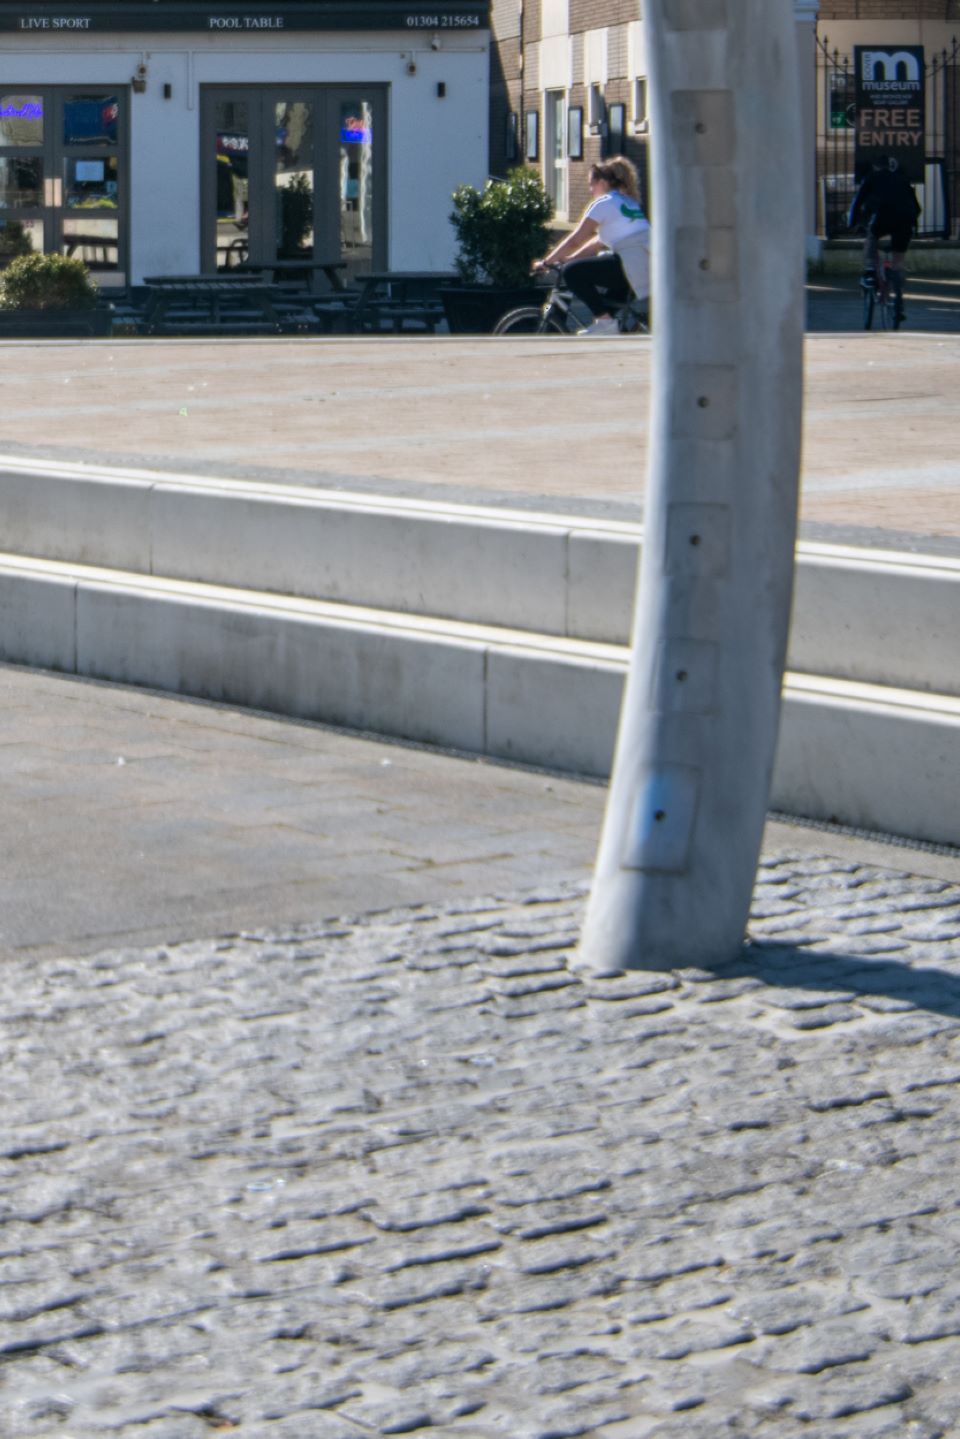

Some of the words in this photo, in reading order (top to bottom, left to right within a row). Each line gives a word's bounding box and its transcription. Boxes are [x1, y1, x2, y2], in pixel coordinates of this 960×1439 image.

[21, 18, 50, 29] LIVE
[52, 18, 91, 29] SPORT
[209, 18, 242, 28] POOL
[243, 18, 284, 28] TABLE
[407, 16, 438, 26] 01304
[440, 16, 479, 26] 215654
[862, 81, 920, 91] museum
[860, 109, 920, 127] FREE
[859, 131, 922, 146] ENTRY
